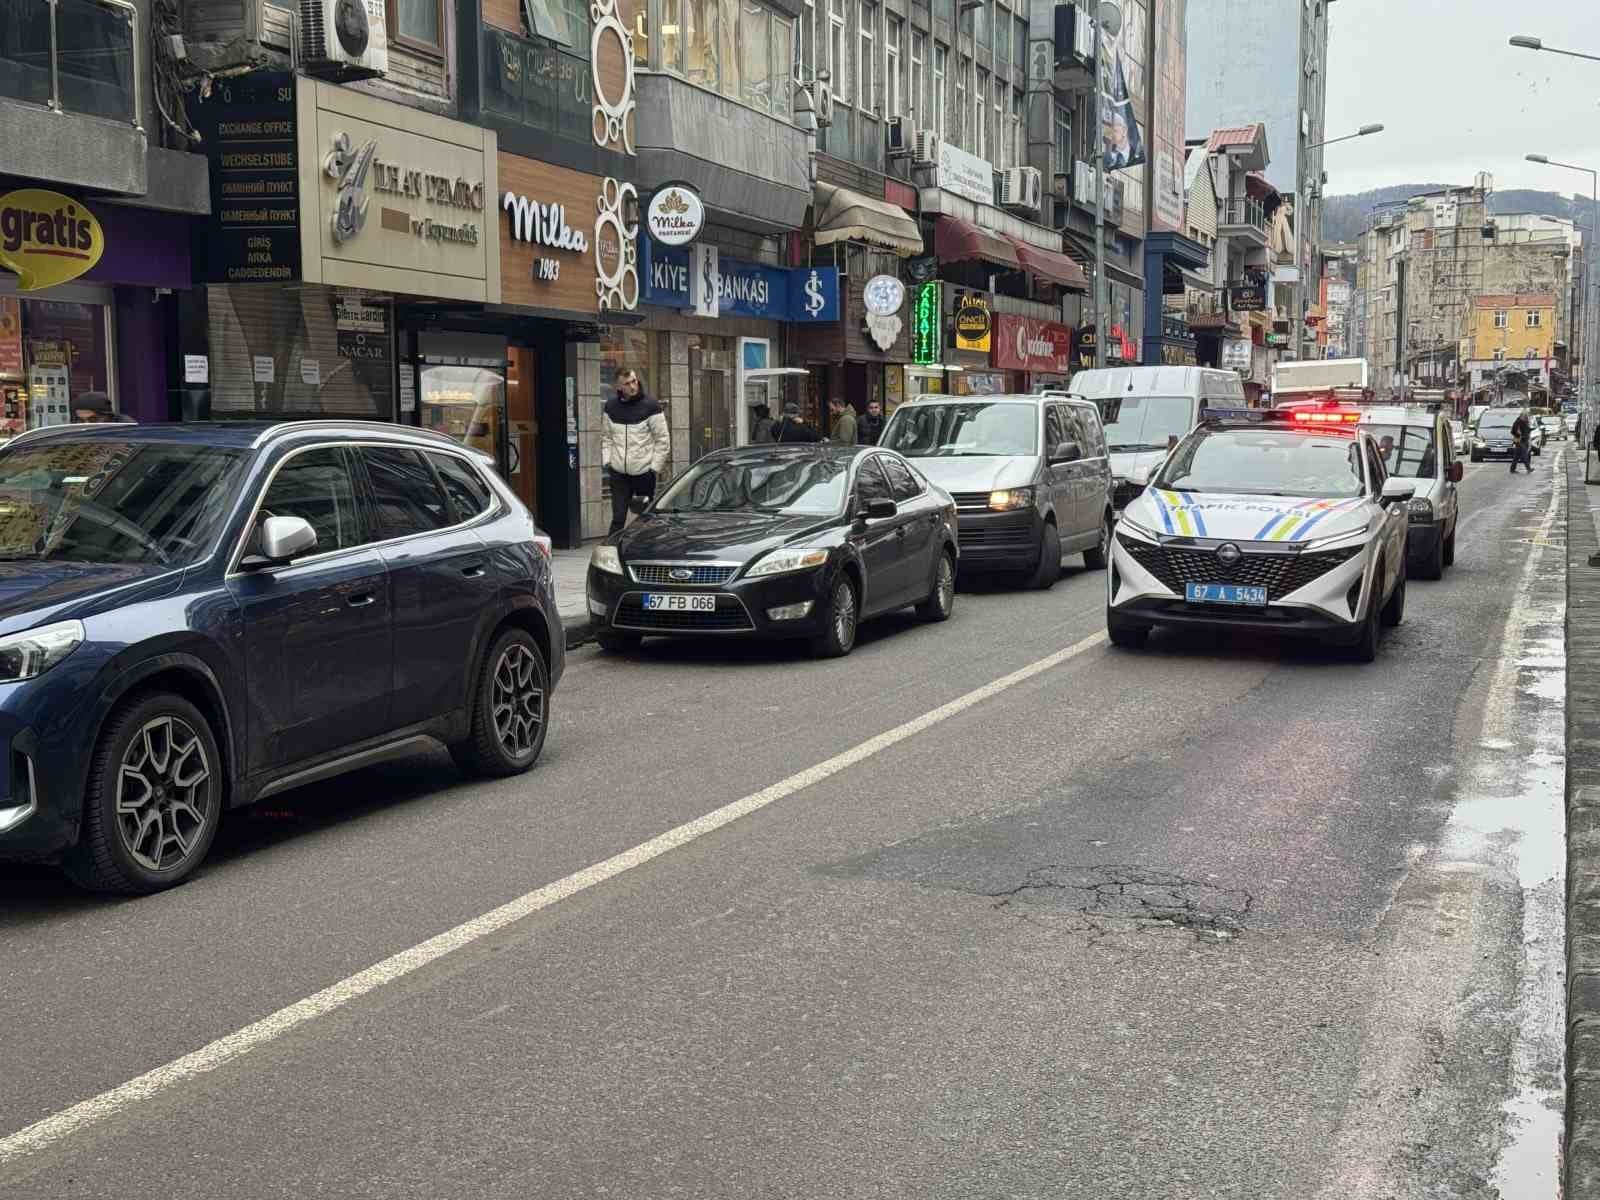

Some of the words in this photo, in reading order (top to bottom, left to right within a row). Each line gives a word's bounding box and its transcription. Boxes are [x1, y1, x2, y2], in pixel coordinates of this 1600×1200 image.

[263, 122, 293, 134] OFFICE
[1, 204, 92, 252] gratis
[504, 191, 589, 253] Milka
[652, 215, 696, 229] Milka
[538, 257, 560, 281] 1983
[651, 258, 688, 292] KİYE
[717, 272, 769, 304] BANKASI
[649, 596, 664, 609] 67
[668, 597, 687, 609] FB
[692, 597, 714, 610] 066
[1194, 585, 1209, 599] 67
[1219, 586, 1225, 599] A
[1236, 588, 1265, 601] 5434
